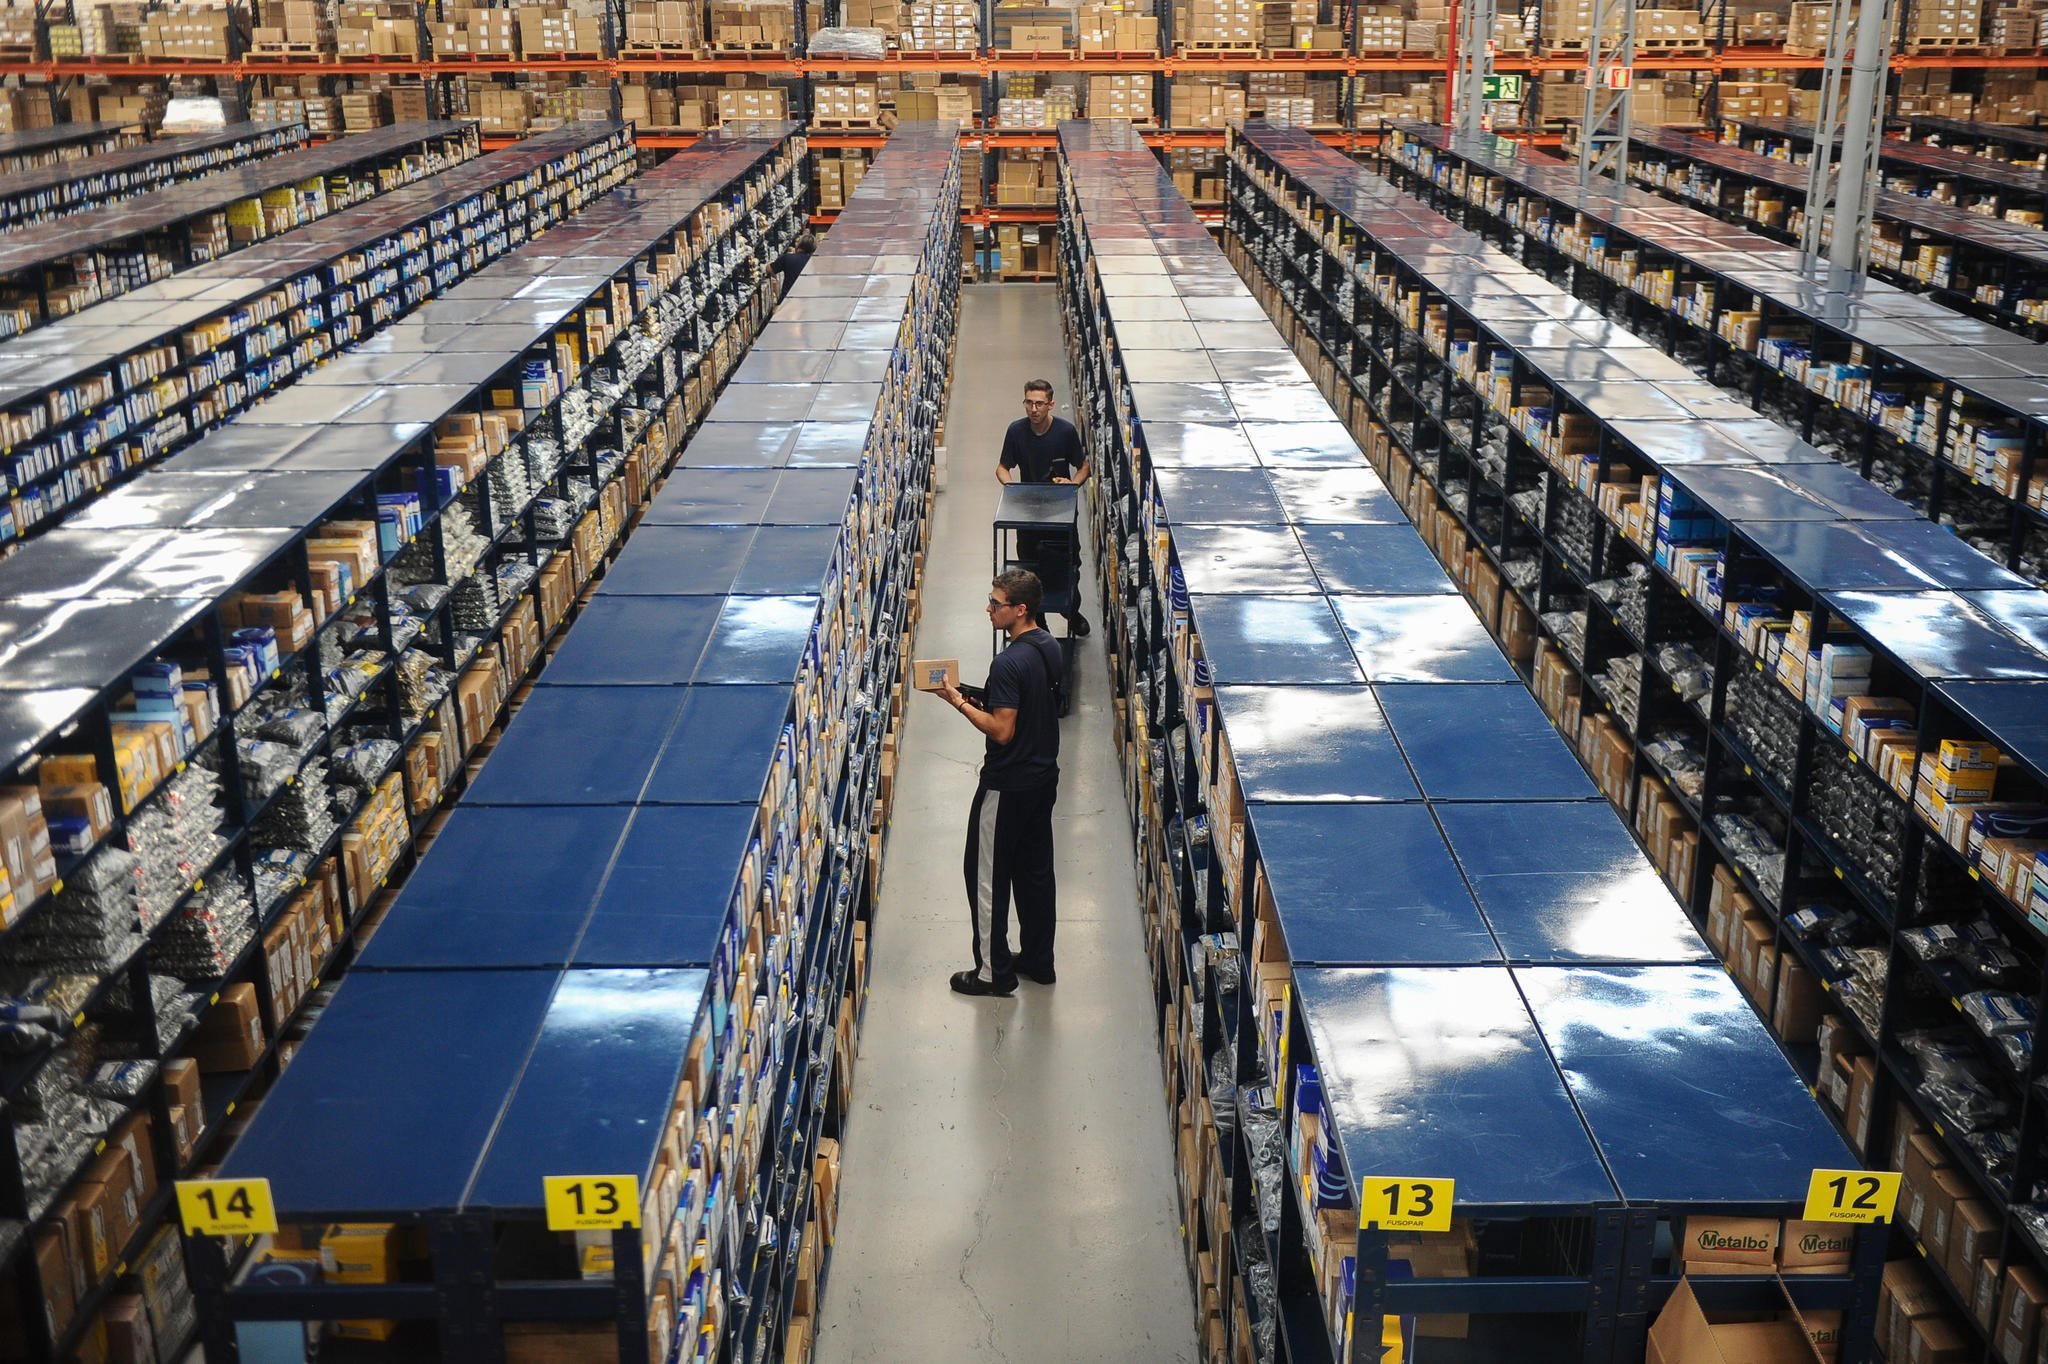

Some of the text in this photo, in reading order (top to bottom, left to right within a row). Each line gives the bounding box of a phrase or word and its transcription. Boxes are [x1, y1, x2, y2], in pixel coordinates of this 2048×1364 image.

[196, 1187, 254, 1220] 14
[566, 1183, 619, 1215] 13
[1382, 1184, 1434, 1217] 13
[1829, 1176, 1881, 1210] 12
[1702, 1234, 1769, 1249] Metalbo
